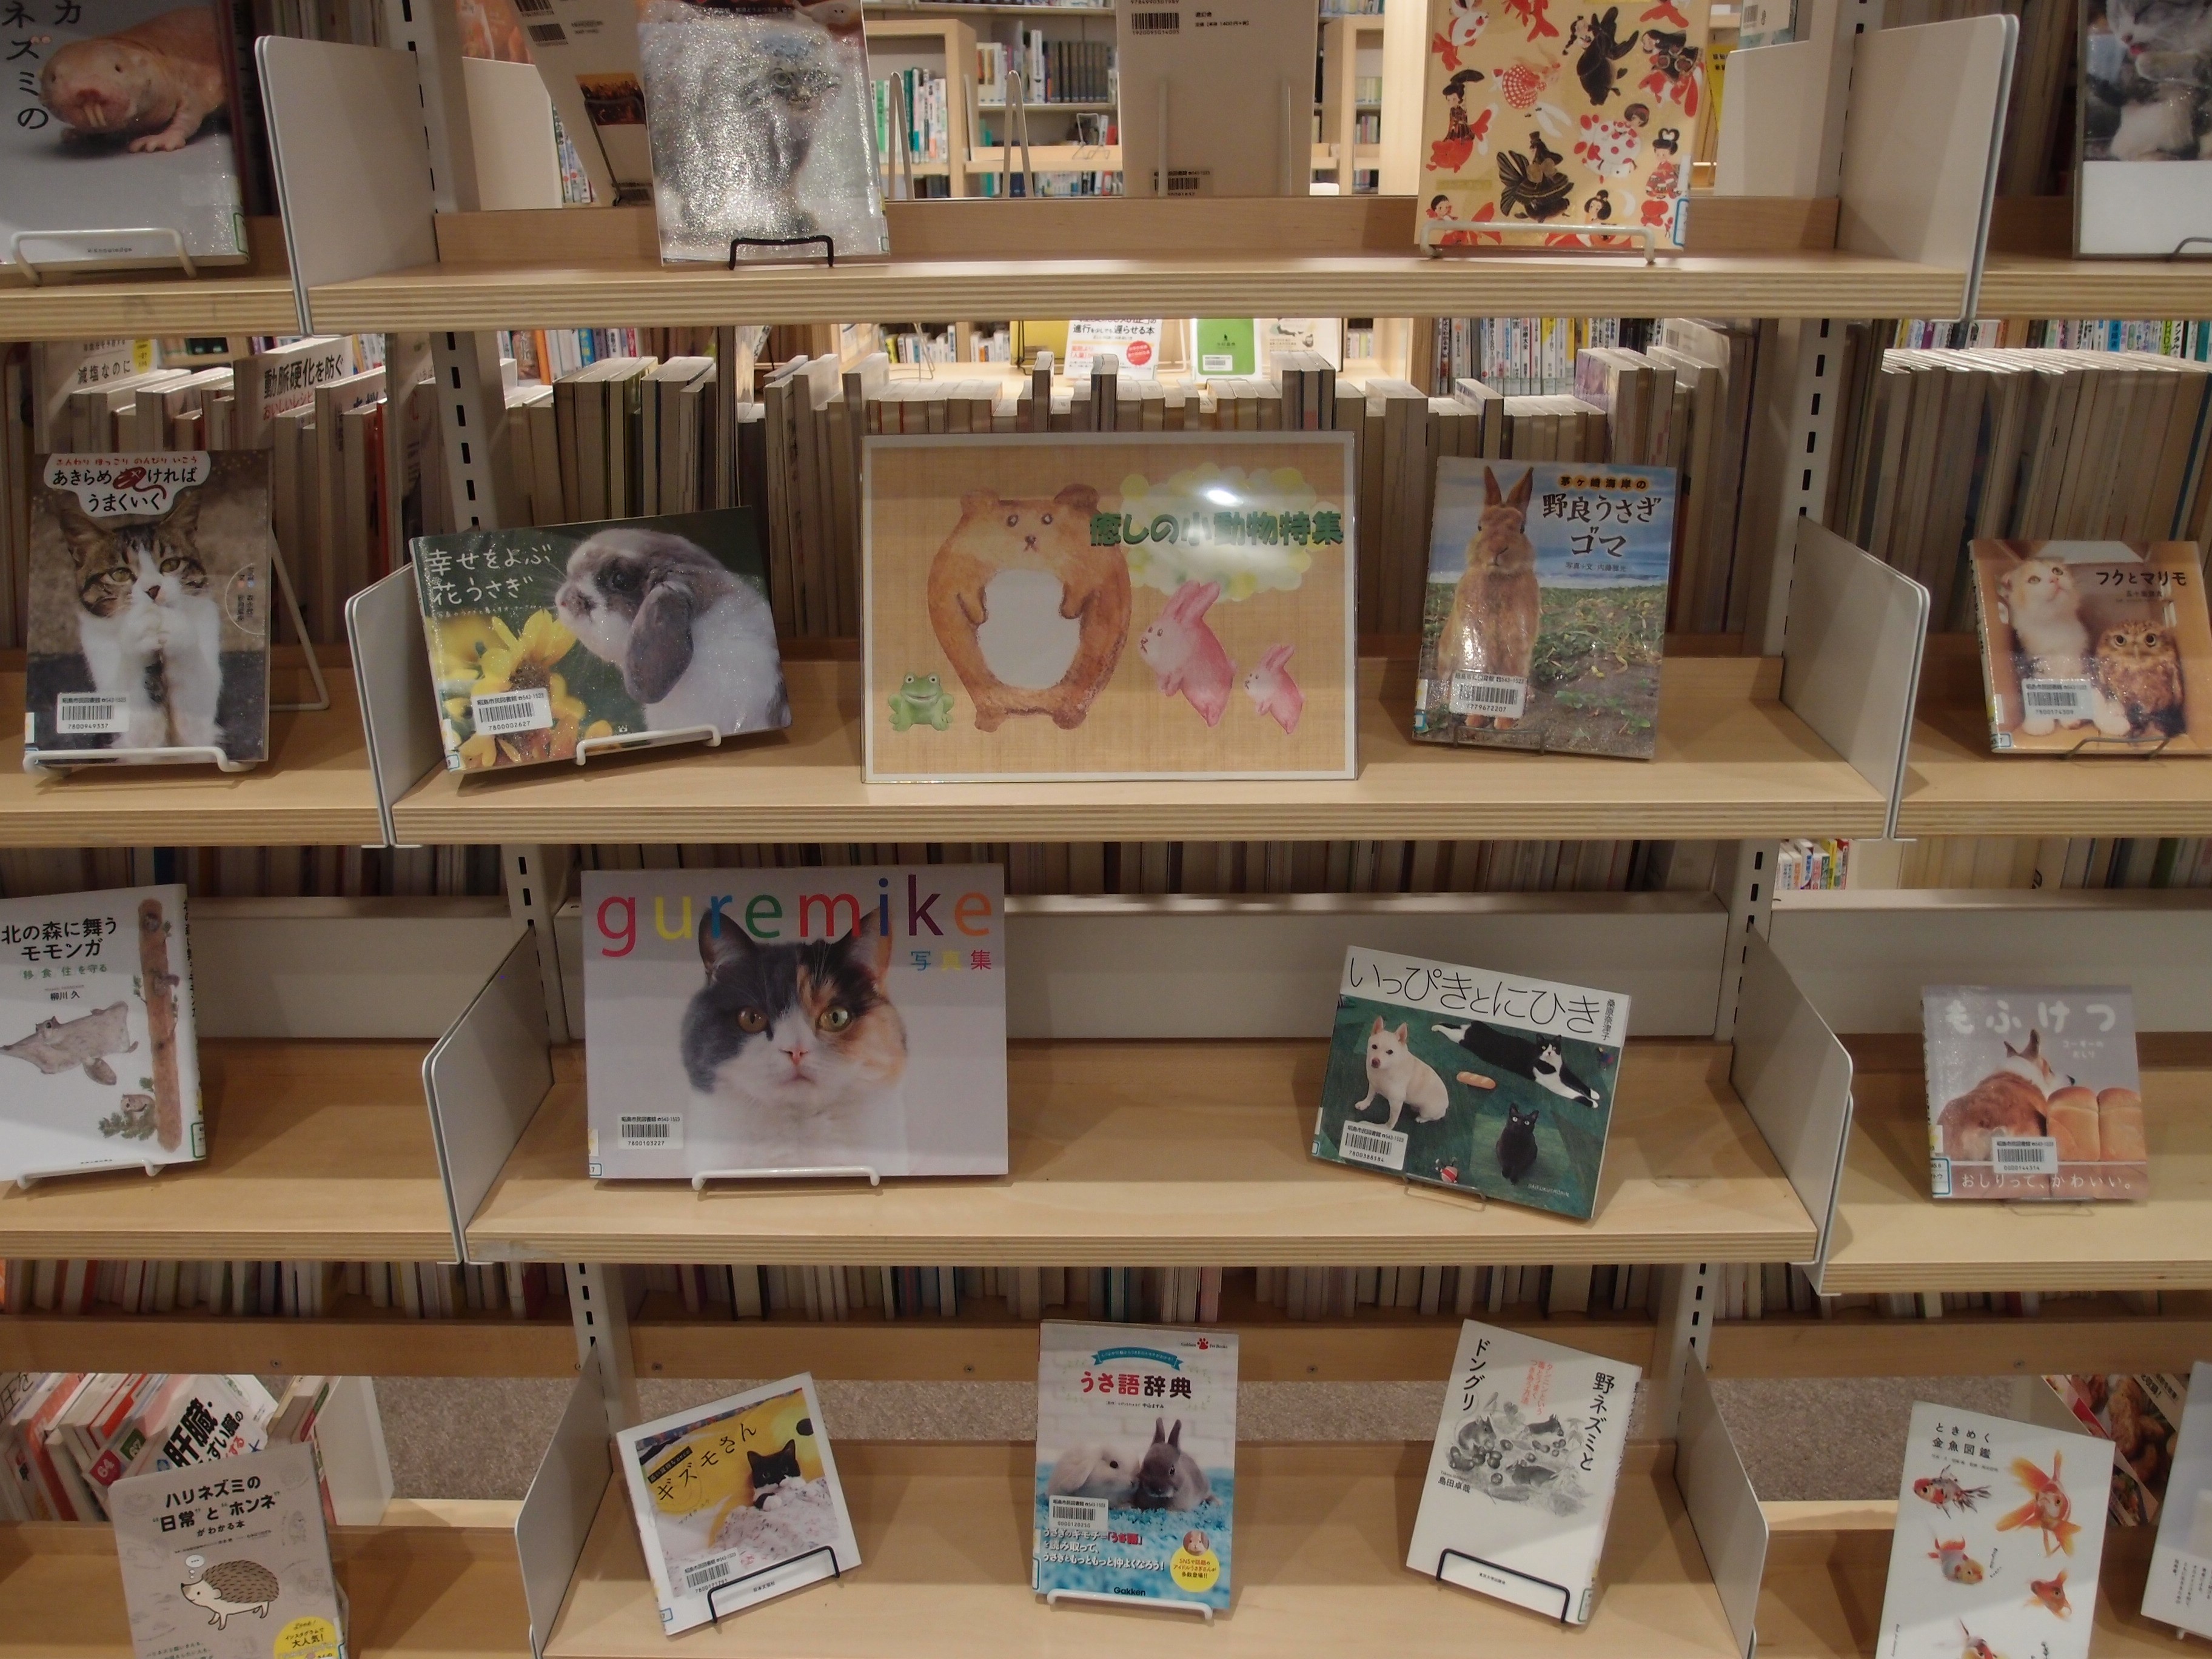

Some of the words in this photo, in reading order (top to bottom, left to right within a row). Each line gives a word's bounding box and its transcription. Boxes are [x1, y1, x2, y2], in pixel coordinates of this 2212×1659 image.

[2, 1, 51, 130] ネズミの
[78, 360, 130, 384] 減塩なのに
[264, 354, 344, 398] 動脈硬化を防ぐ
[89, 493, 159, 512] うまくいく
[1543, 493, 1661, 523] 野良うさぎ
[1090, 511, 1344, 546] 癒しの小動物特集
[1570, 526, 1627, 557] ゴマ
[424, 544, 552, 576] 幸せをよぶ
[426, 575, 534, 606] 花うさぎ
[2096, 569, 2187, 586] フクとマリモ
[1, 916, 118, 945] 北の森に舞う
[597, 874, 993, 957] guremike
[21, 939, 103, 962] モモンガ
[910, 949, 993, 971] 写真集
[1350, 957, 1600, 1034] いっぴきとにひき
[1945, 999, 2116, 1033] もふけつ
[1962, 1172, 2131, 1190] おしりって、かわいい。
[1080, 1370, 1193, 1399] うさ語辞典
[1463, 1338, 1491, 1412] ドングリ
[1580, 1371, 1615, 1471] 野ネズミと
[1936, 1423, 1989, 1443] ときめく
[657, 1423, 757, 1501] ギズモさん
[1932, 1437, 1991, 1459] 金魚図鑑
[166, 1476, 261, 1508] ハリネズミの
[196, 1520, 245, 1537] がわかる本
[1113, 1586, 1147, 1597] Gakken
[292, 1633, 325, 1649] 大人気!
